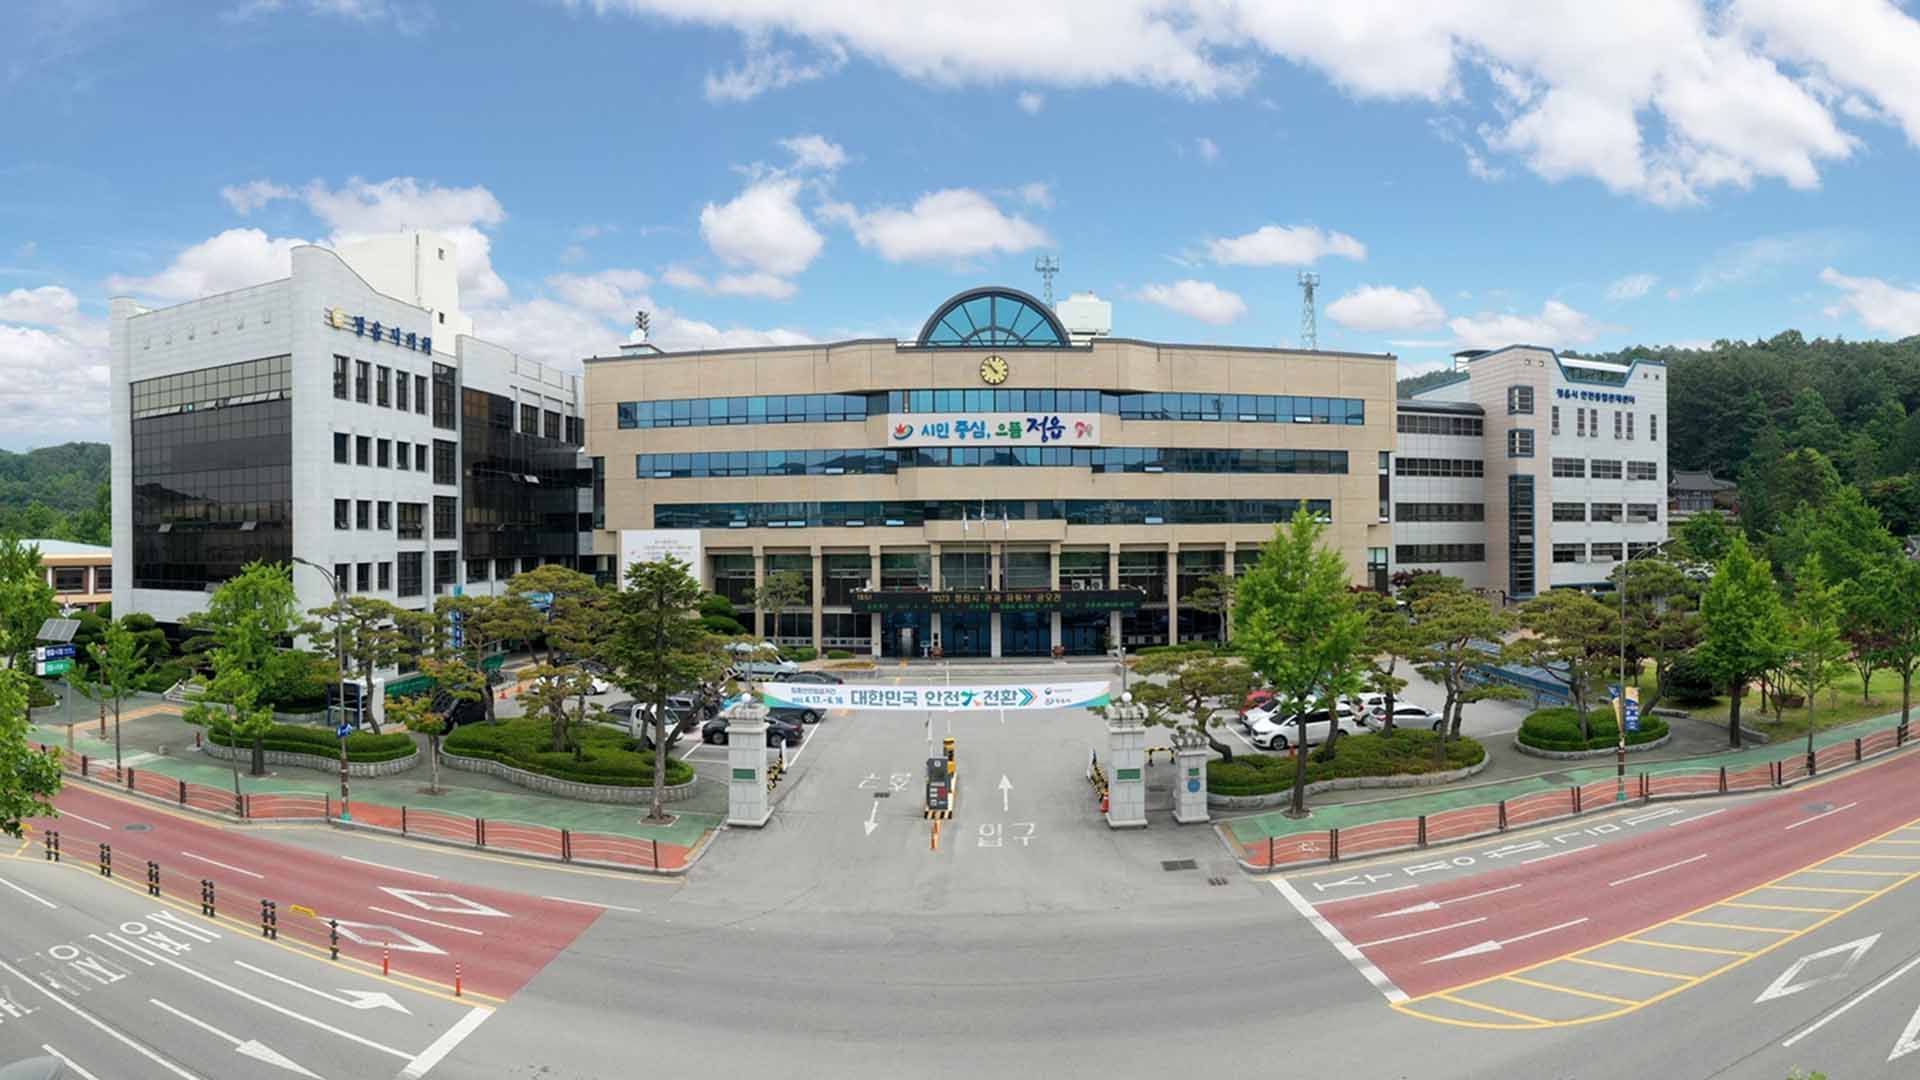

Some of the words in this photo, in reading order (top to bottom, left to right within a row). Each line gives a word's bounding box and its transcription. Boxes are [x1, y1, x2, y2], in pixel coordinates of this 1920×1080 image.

[921, 421, 949, 439] 시민
[954, 420, 990, 440] 중심,
[995, 421, 1022, 439] 으뜸
[1026, 416, 1066, 443] 정읍
[850, 690, 918, 707] 대한민국
[977, 823, 1038, 848] 입구
